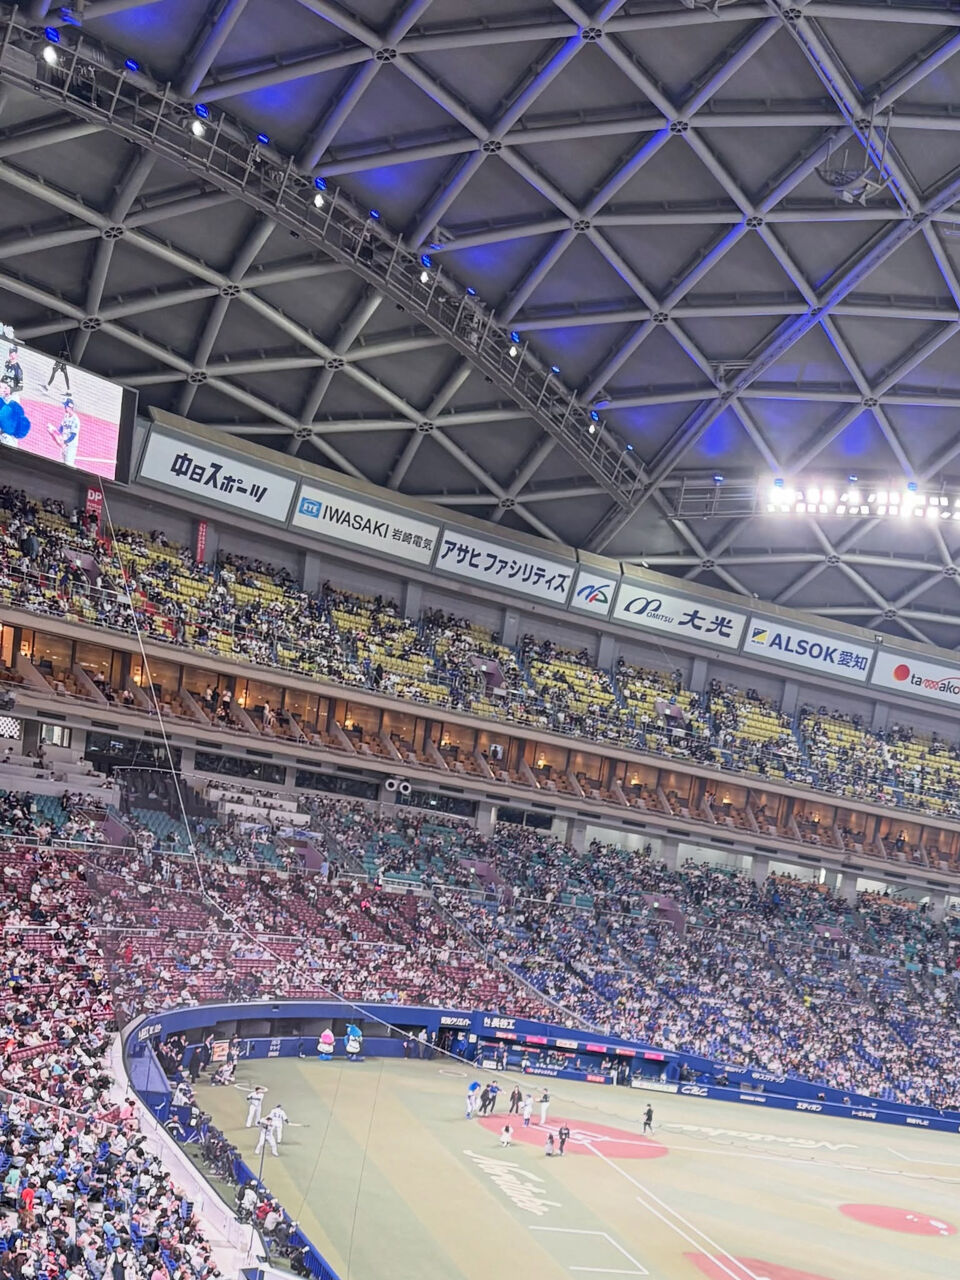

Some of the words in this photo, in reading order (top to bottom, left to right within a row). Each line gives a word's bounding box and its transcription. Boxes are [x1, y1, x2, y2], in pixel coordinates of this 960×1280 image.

[170, 453, 268, 502] 中日スポーツ
[322, 505, 390, 539] IWASAKI
[392, 528, 432, 550] 岩崎電気
[677, 609, 734, 638] 大光
